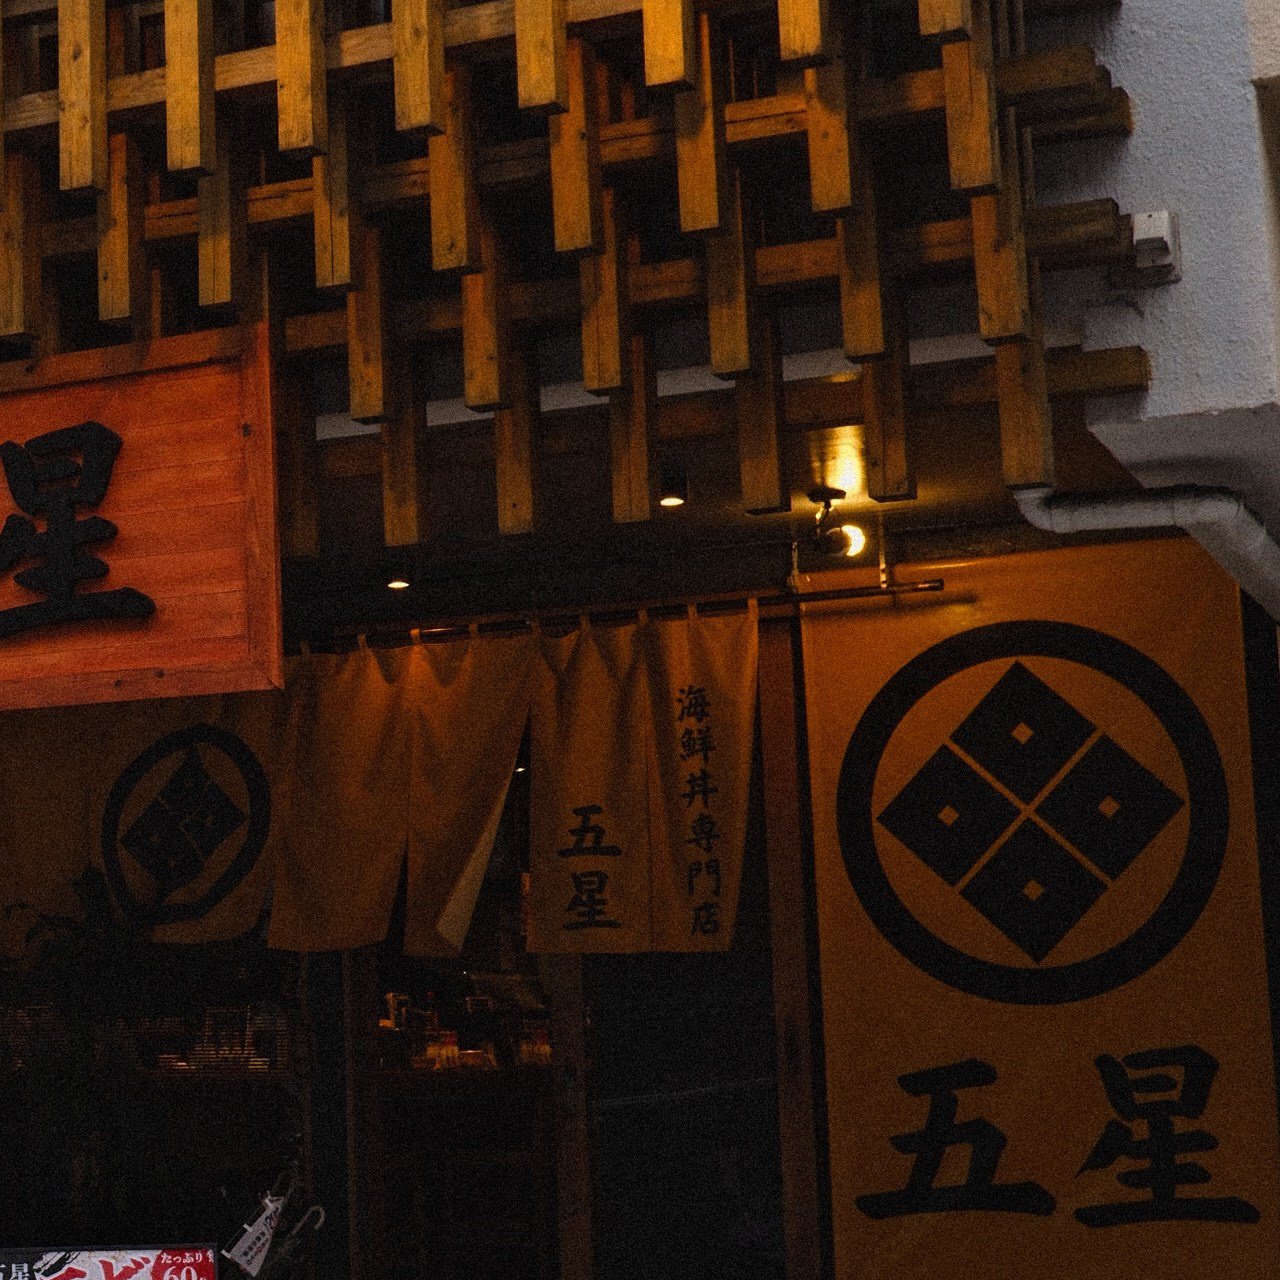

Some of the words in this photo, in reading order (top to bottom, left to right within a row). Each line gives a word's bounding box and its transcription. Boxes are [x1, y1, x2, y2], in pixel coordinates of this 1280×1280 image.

[557, 803, 622, 931] 五星
[675, 684, 721, 936] 海鮮丼専門店
[854, 1044, 1262, 1228] 五星
